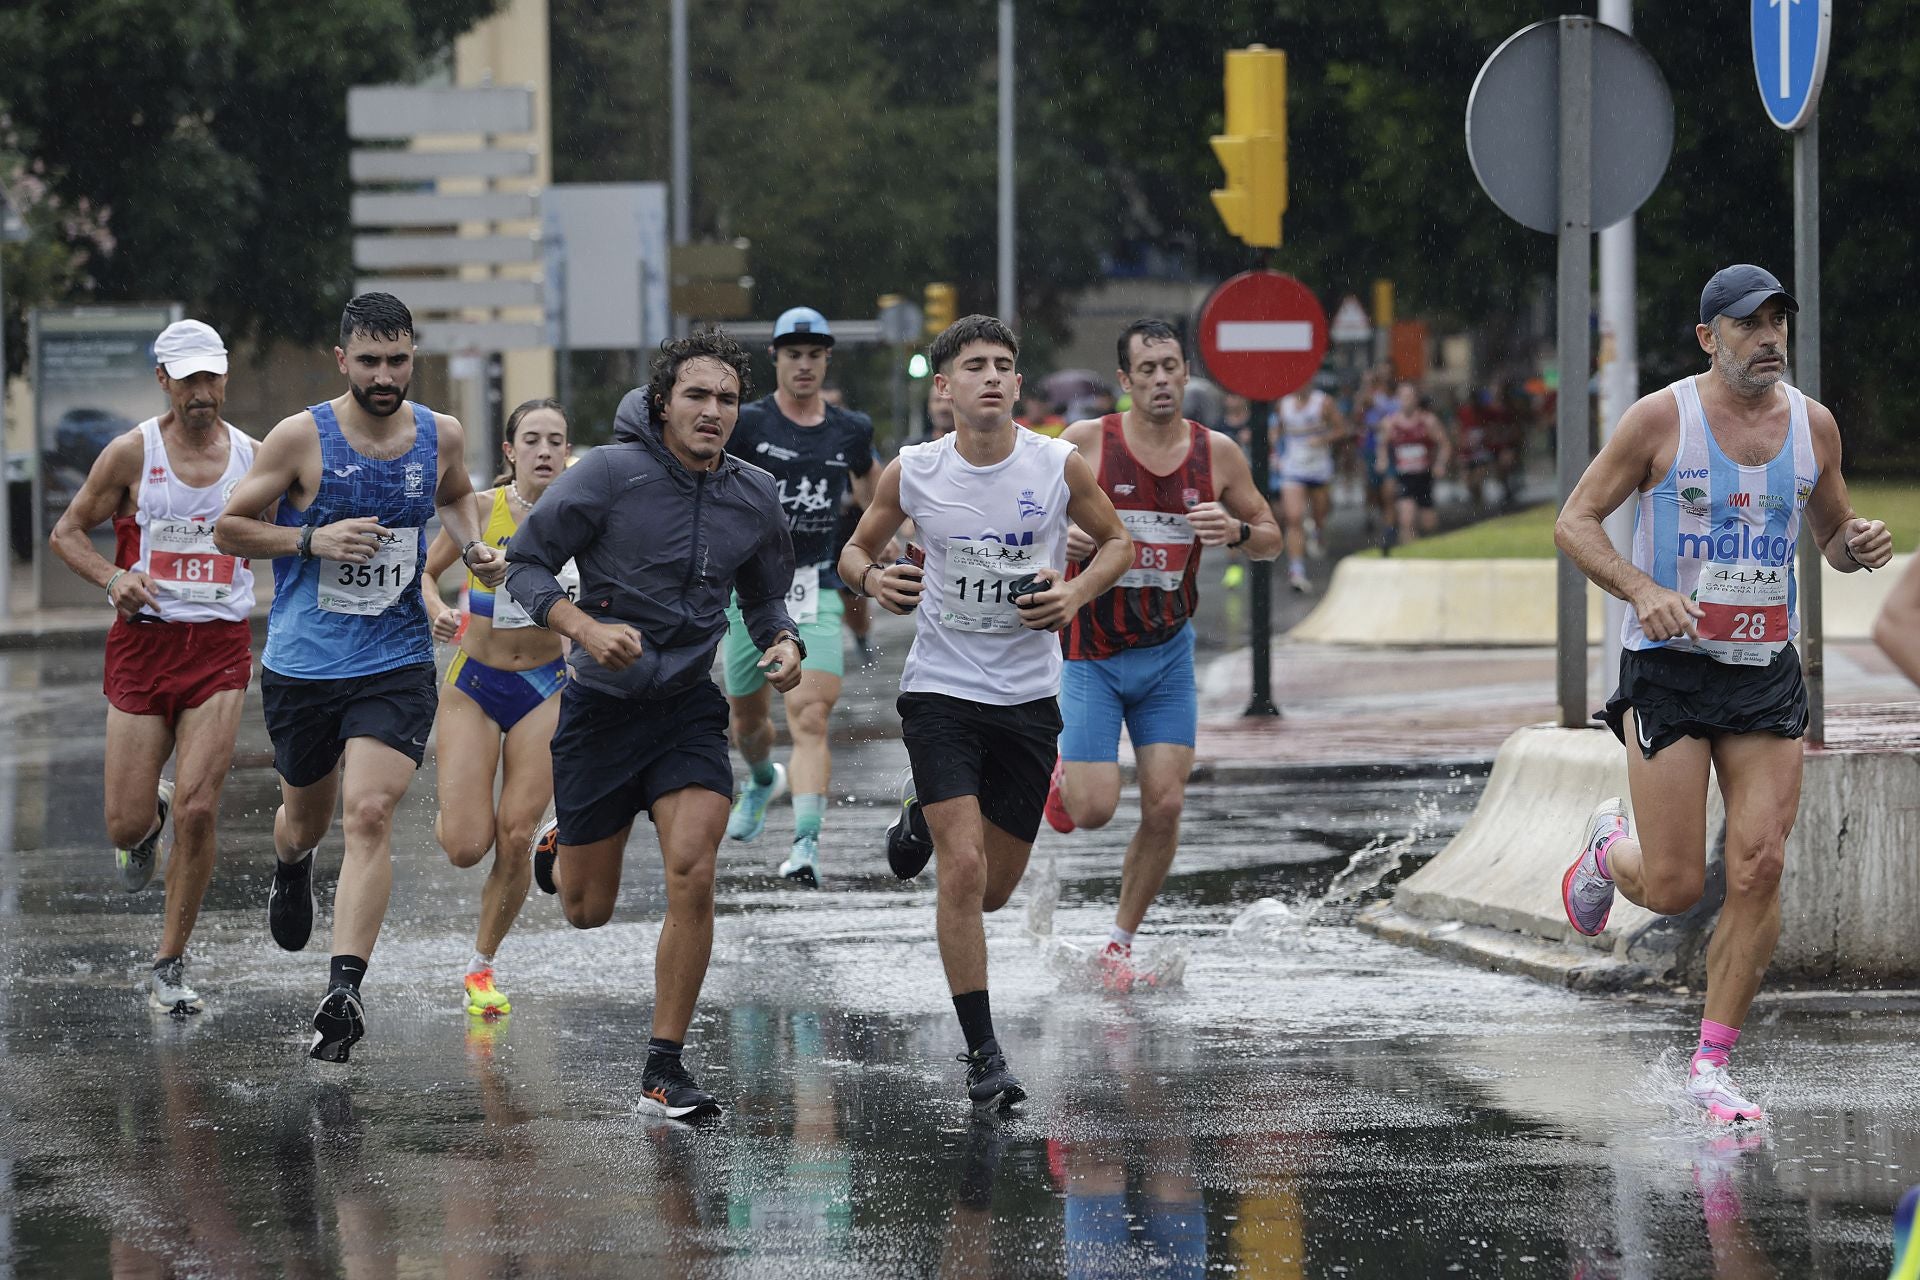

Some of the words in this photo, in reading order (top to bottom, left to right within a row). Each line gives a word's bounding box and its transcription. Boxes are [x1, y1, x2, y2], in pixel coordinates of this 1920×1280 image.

[1678, 468, 1709, 479] vive
[1759, 493, 1784, 501] metro
[1141, 546, 1168, 570] 83
[172, 559, 215, 581] 181
[338, 563, 401, 588] 3511
[1714, 570, 1745, 582] 44
[1730, 612, 1766, 640] 28
